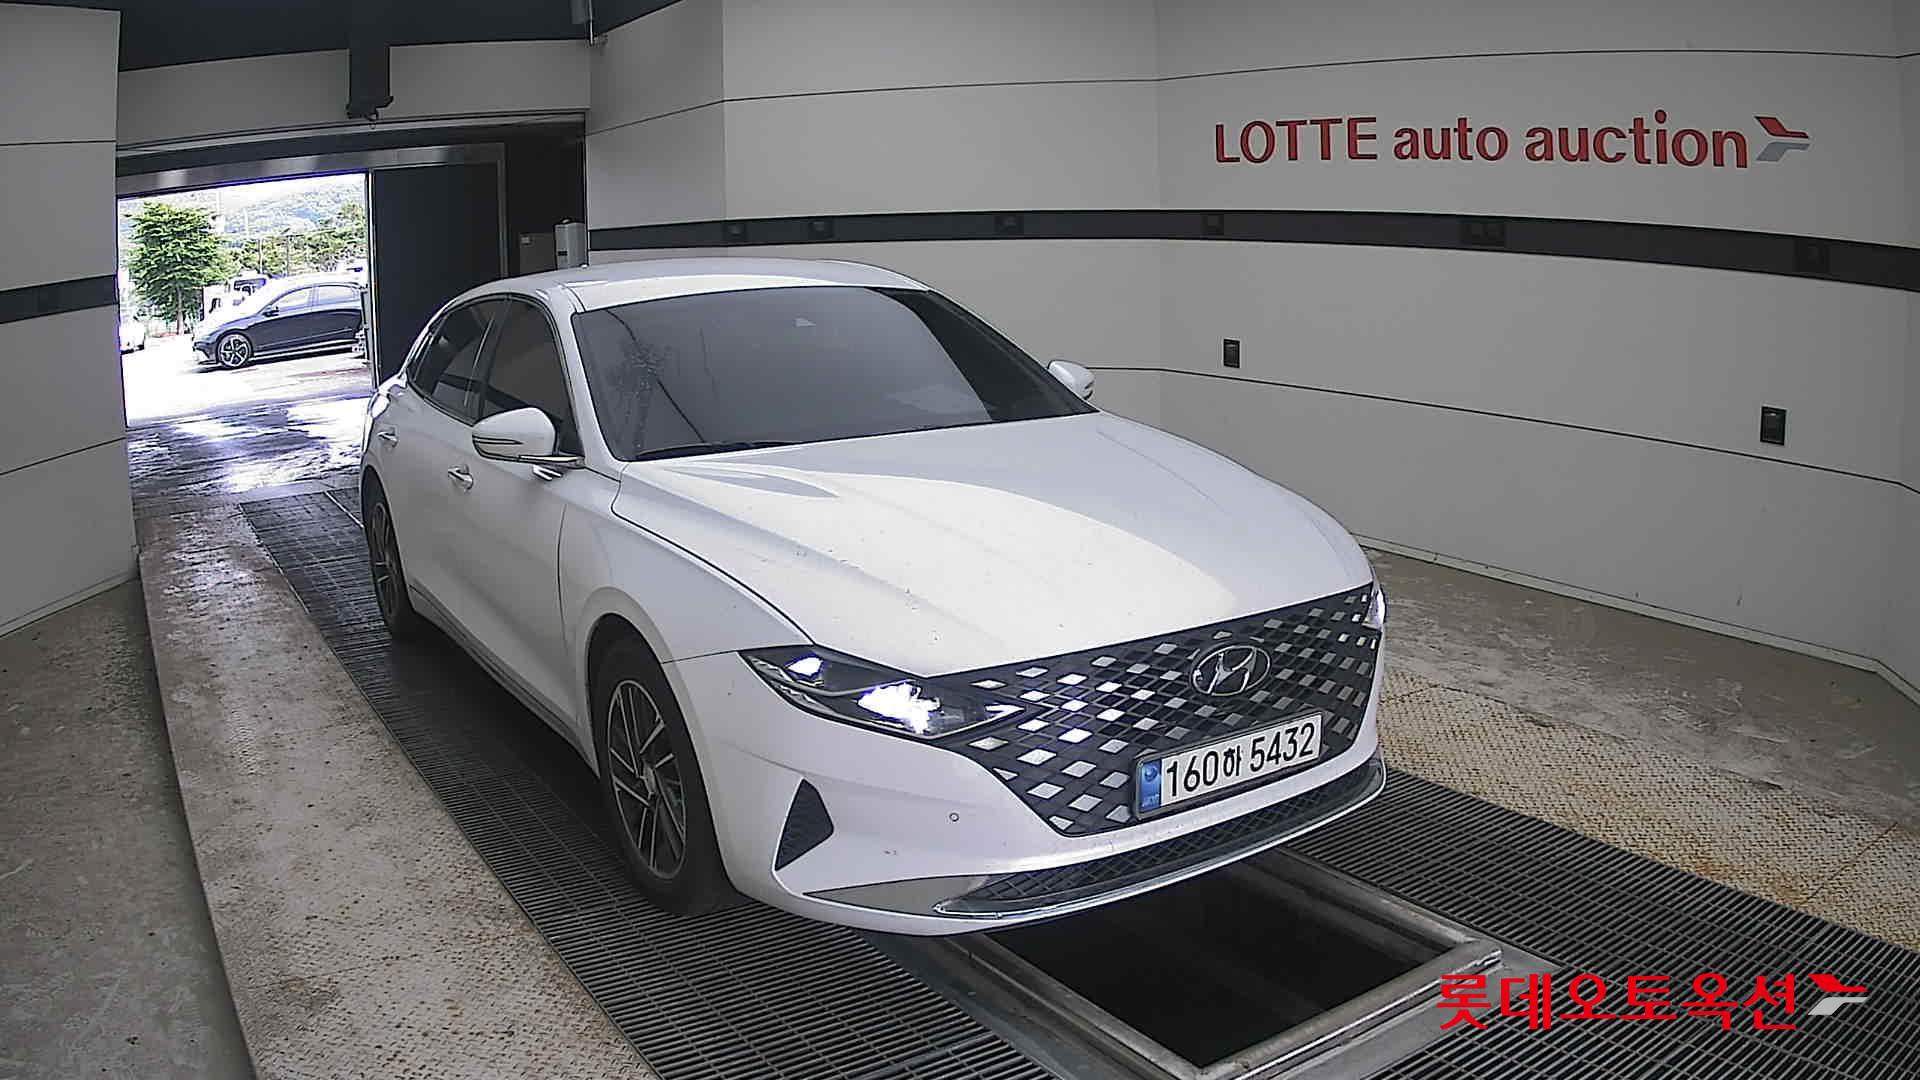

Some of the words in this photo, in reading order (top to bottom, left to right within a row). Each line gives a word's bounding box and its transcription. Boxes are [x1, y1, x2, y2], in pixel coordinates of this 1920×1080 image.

[1214, 116, 1378, 164] LOTTE
[1393, 117, 1509, 161] auto
[1524, 109, 1749, 169] auction
[1166, 745, 1242, 797] 160하
[1250, 722, 1315, 773] 5432
